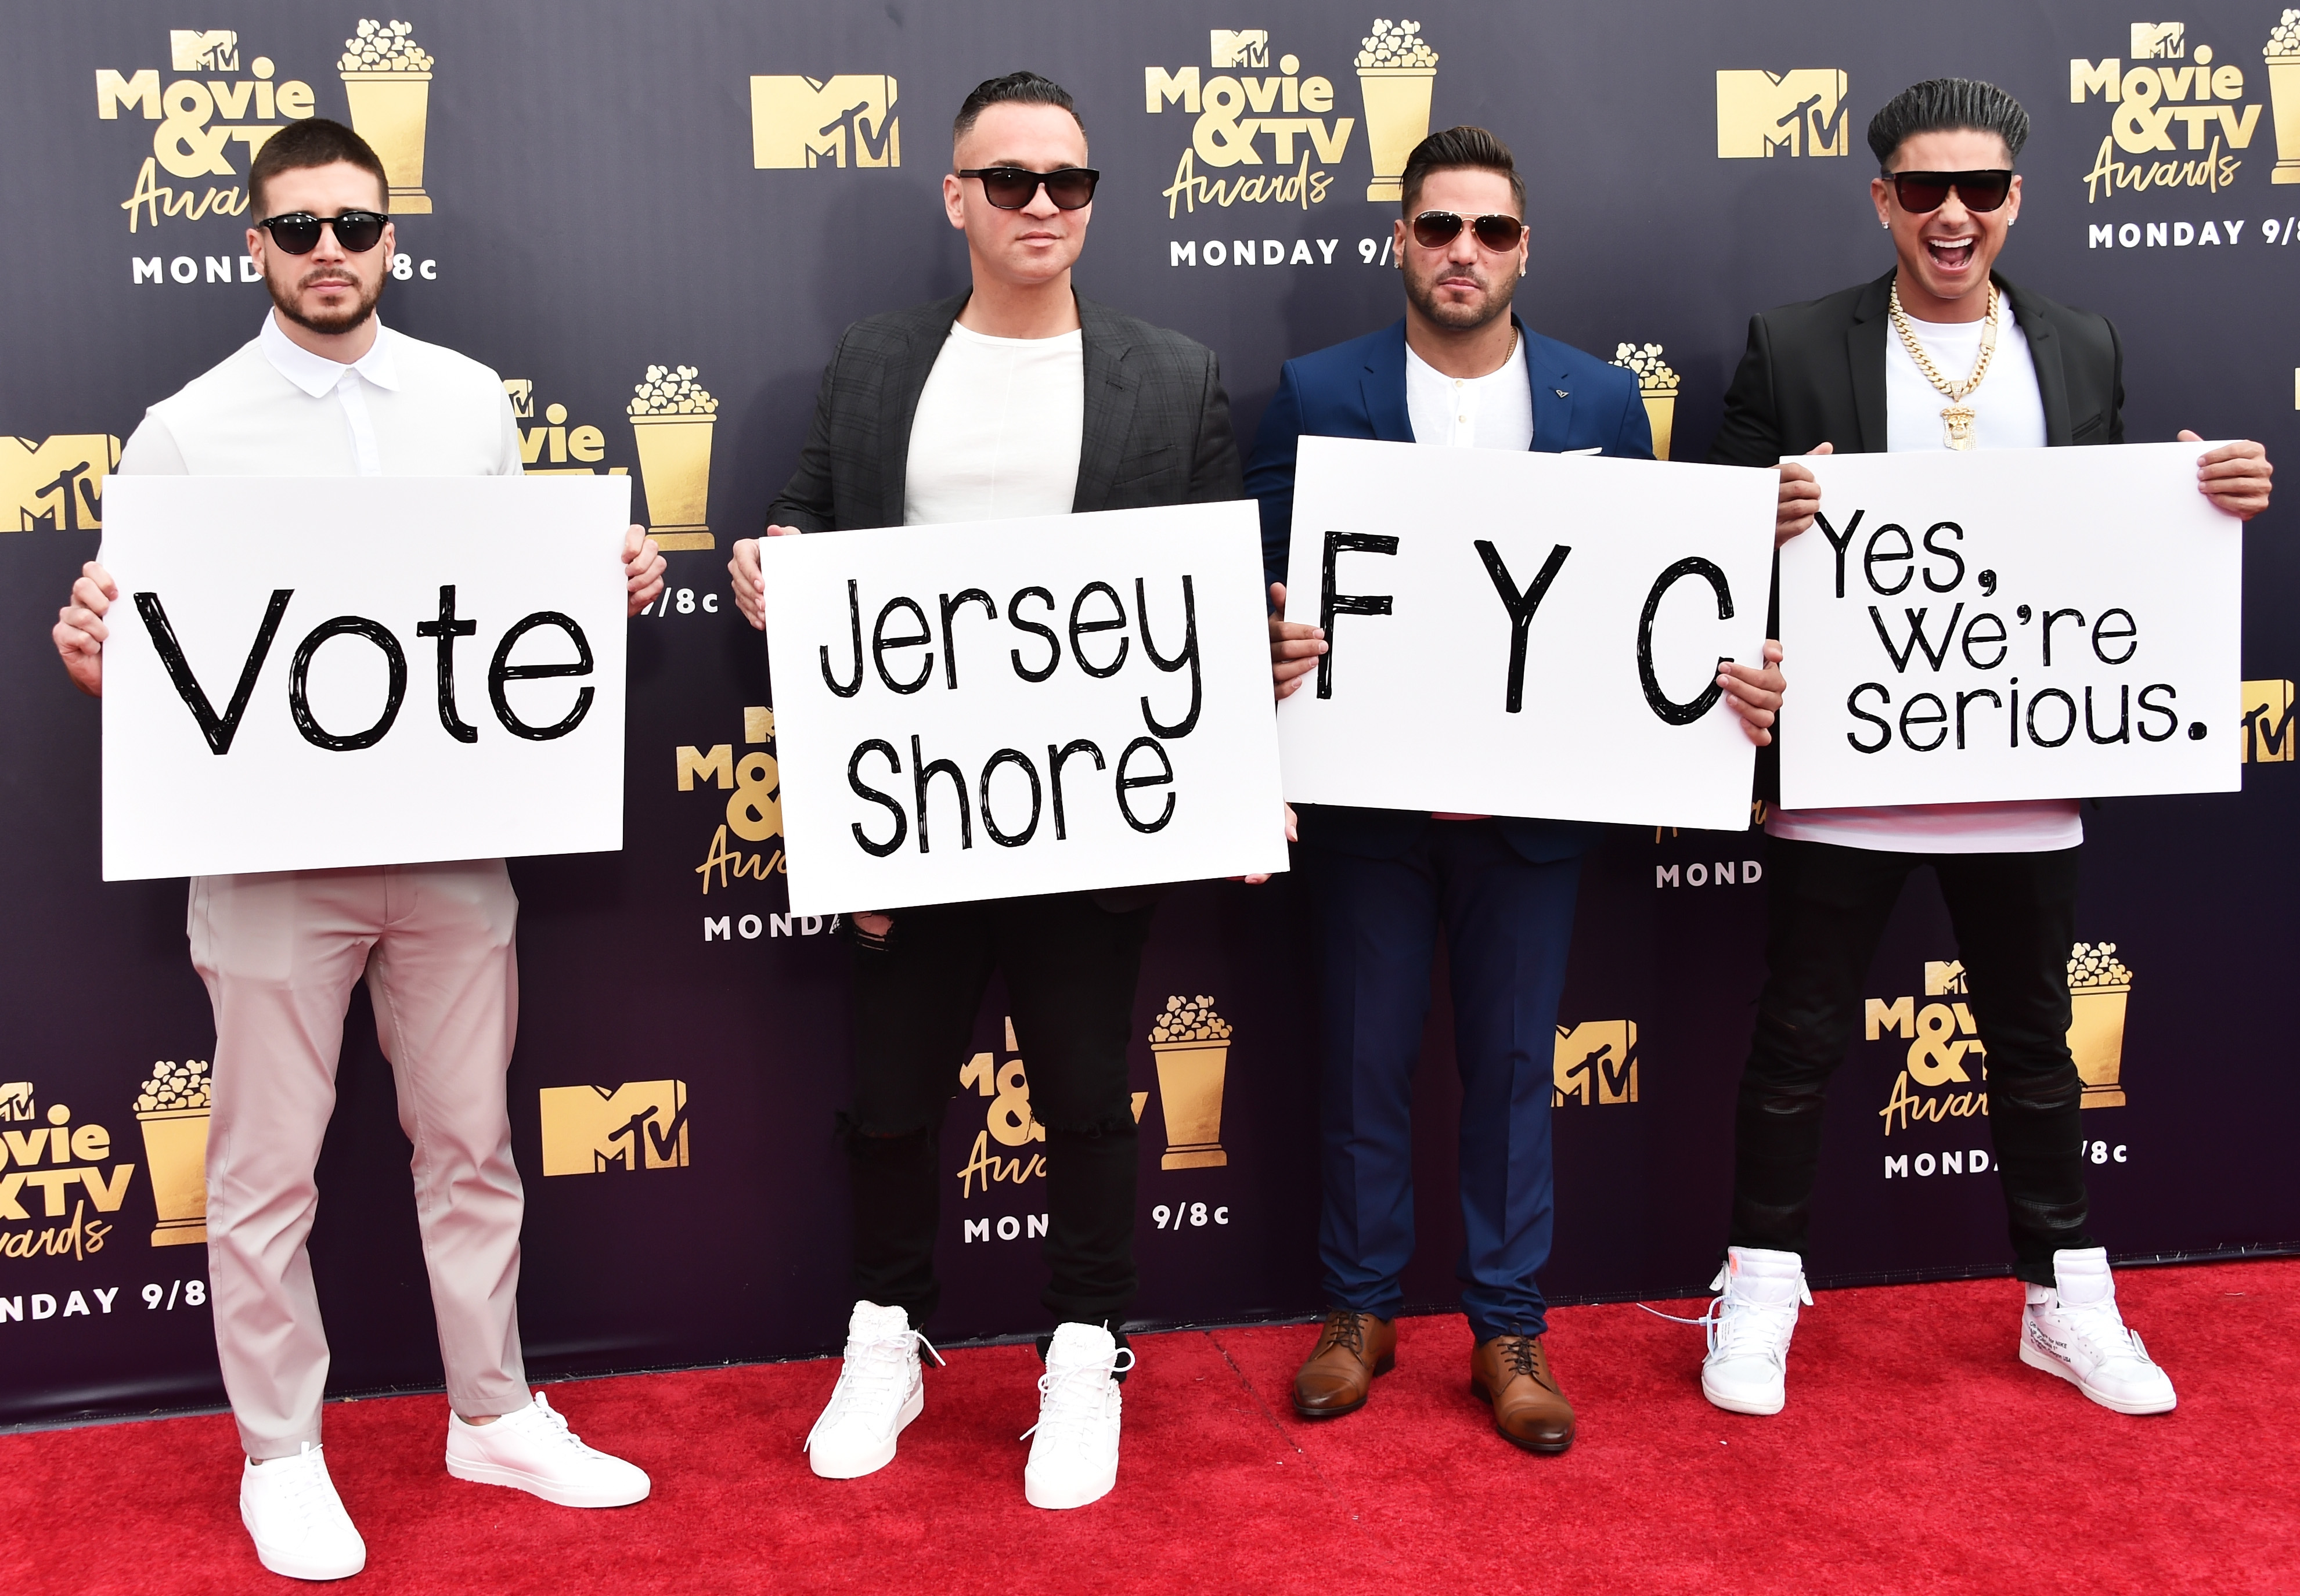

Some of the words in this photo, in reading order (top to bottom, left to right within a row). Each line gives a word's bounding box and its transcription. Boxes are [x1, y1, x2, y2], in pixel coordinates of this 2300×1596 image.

[170, 30, 239, 71] MTV
[1210, 29, 1269, 68] MTV
[2130, 22, 2184, 59] MTV
[95, 57, 315, 120] Movie
[1145, 54, 1334, 114] Movie
[2070, 44, 2244, 103] Movie
[750, 74, 900, 169] MTV
[1191, 115, 1355, 168] &TV
[1716, 68, 1848, 158] MTV
[2111, 104, 2263, 154] &TV
[153, 118, 288, 178] &T
[2082, 135, 2242, 204] Awards
[121, 157, 250, 233] Awa
[1162, 148, 1334, 219] Awards
[1170, 238, 1339, 266] MONDAY
[1358, 236, 1393, 266] 9/
[2089, 220, 2245, 248] MONDAY
[2262, 217, 2300, 245] 9/
[132, 256, 265, 285] MOND
[392, 253, 437, 280] 8c
[517, 403, 605, 463] vie
[1814, 509, 1997, 598] Yes,
[820, 575, 1202, 739] Jersey
[1868, 602, 2137, 673] We're
[133, 584, 595, 756] Vote
[1847, 677, 2207, 754] Serious.
[848, 734, 1176, 858] Shore
[1656, 861, 1762, 888] MOND
[704, 913, 840, 941] MOND
[540, 1079, 690, 1177] MTV
[1879, 1071, 1989, 1136] Awar
[0, 1104, 110, 1172] vie
[1885, 1150, 1998, 1179] MOND
[0, 1200, 113, 1261] ards
[964, 1214, 1049, 1243] MON
[1152, 1202, 1228, 1230] 9/8c
[0, 1287, 119, 1323] NDAY
[142, 1280, 206, 1310] 9/8
[2056, 1340, 2067, 1349] NIKE
